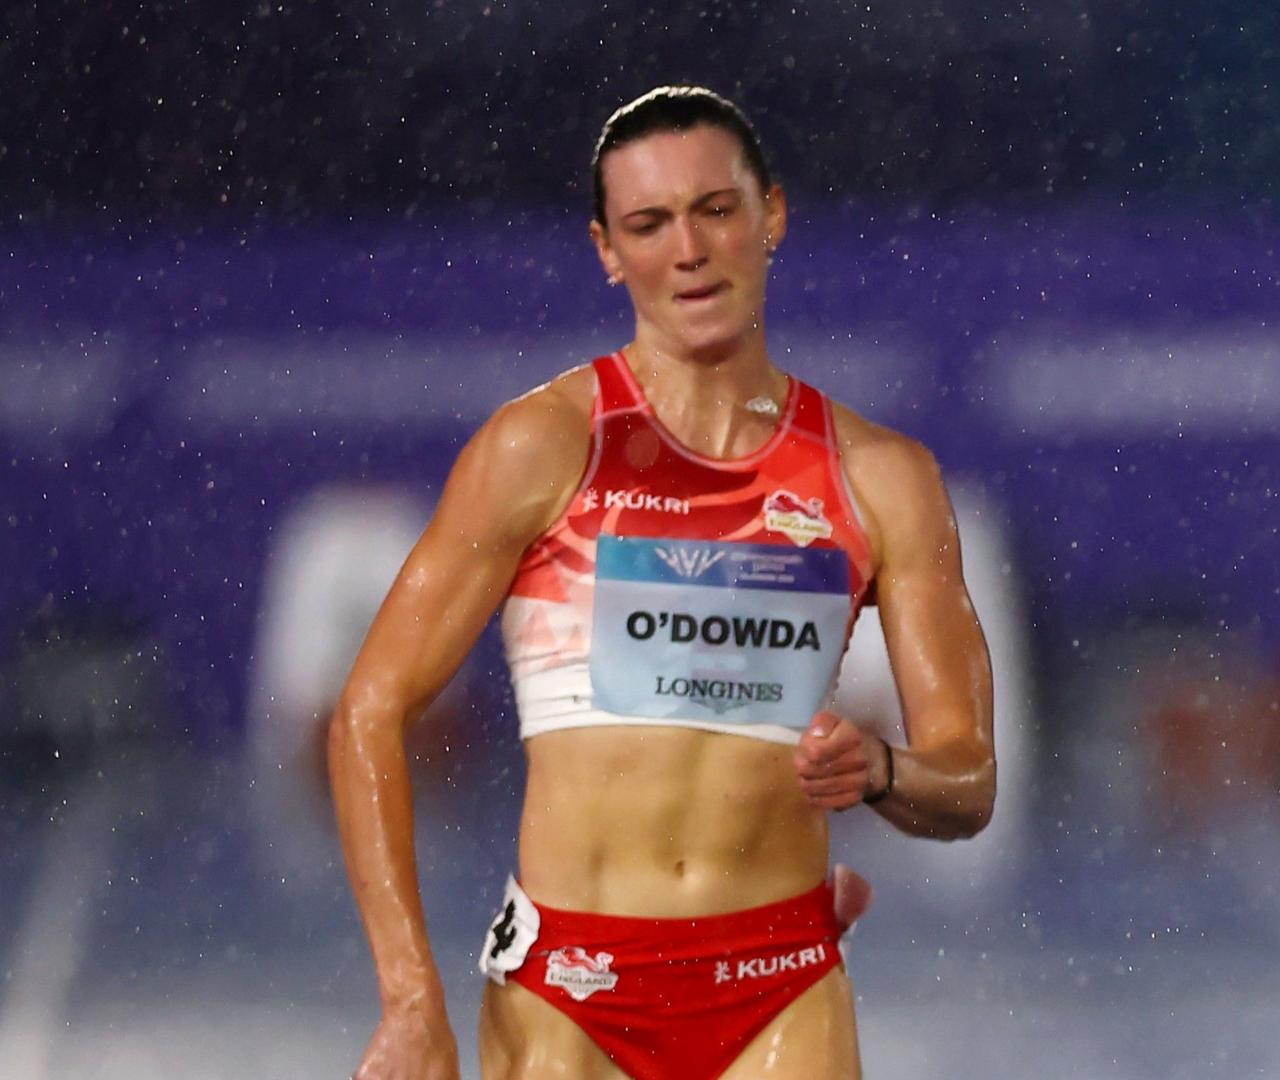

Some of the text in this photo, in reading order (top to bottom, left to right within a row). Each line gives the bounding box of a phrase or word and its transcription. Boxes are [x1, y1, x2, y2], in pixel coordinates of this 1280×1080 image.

[604, 490, 690, 514] KUKRI
[626, 611, 822, 650] O'DOWDA
[655, 676, 784, 702] LONGINES
[737, 944, 827, 980] KUKRI
